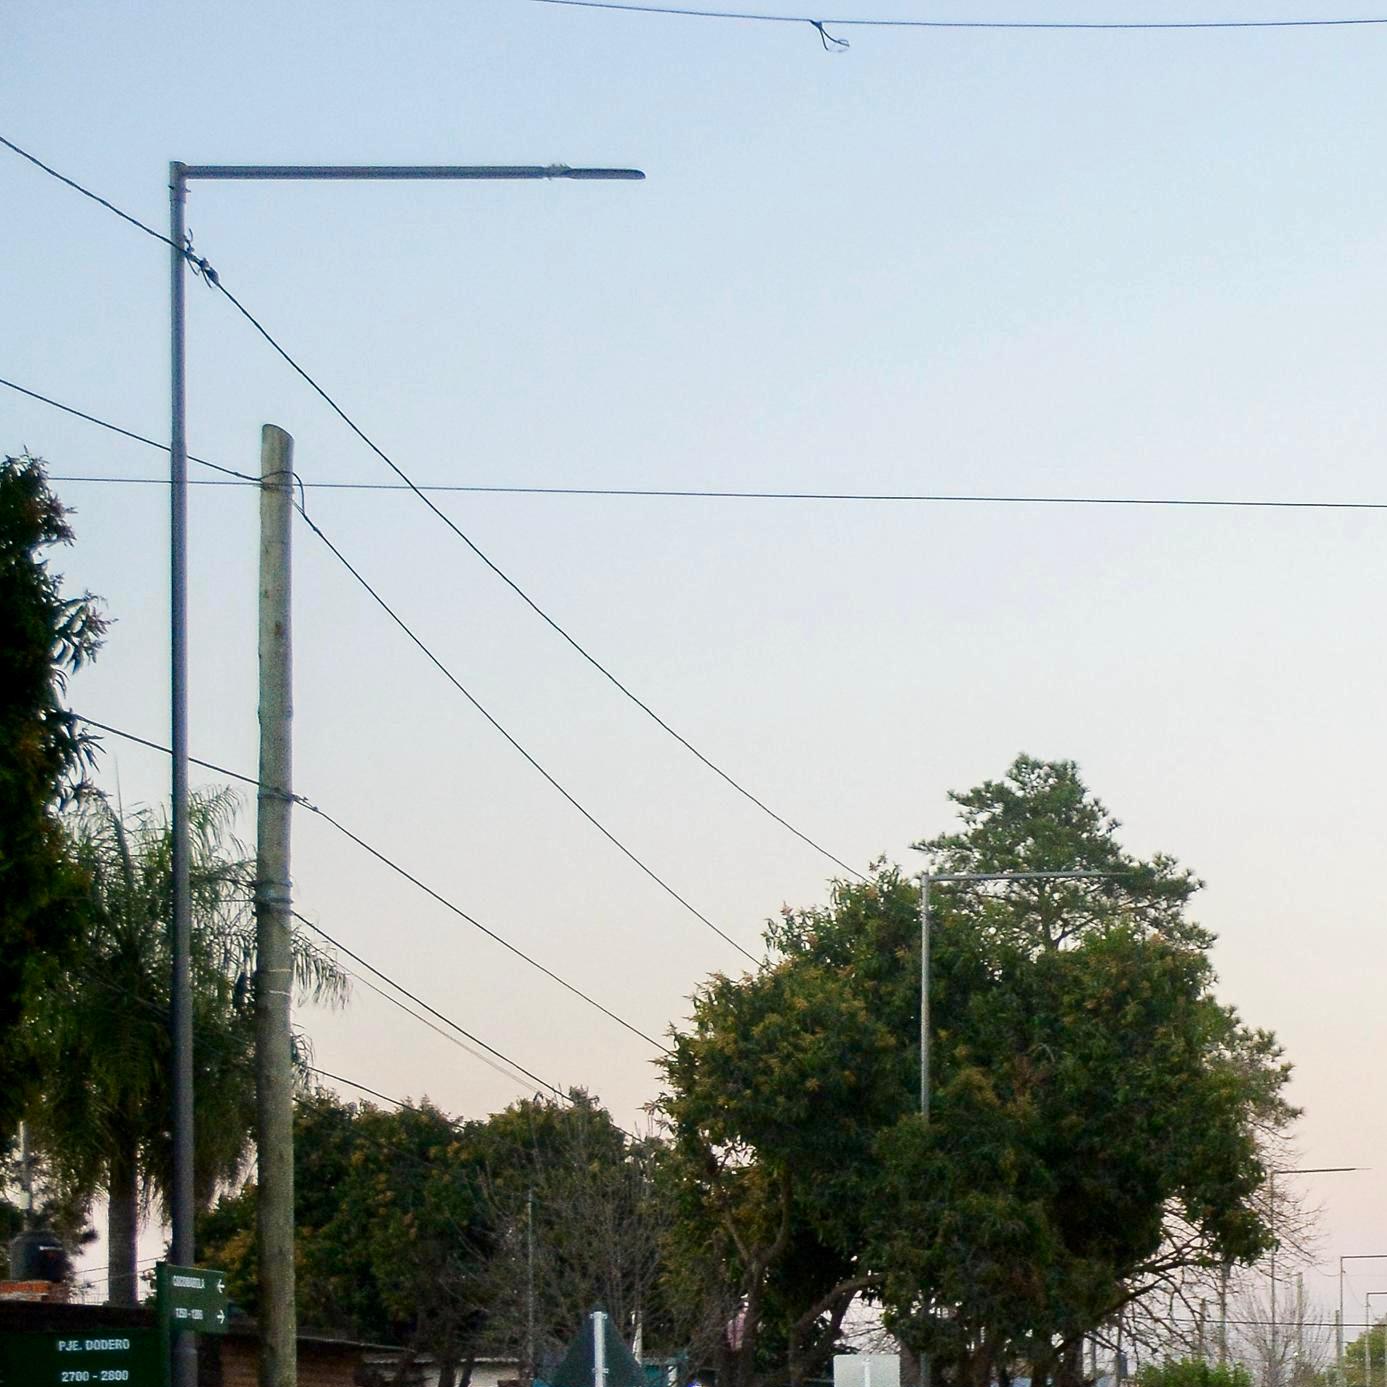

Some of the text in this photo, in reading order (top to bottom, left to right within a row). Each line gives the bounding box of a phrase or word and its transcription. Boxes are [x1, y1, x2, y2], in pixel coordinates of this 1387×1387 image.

[58, 1338, 130, 1351] PJE. DODERO
[61, 1371, 90, 1382] 2700
[100, 1369, 129, 1381] 2800
